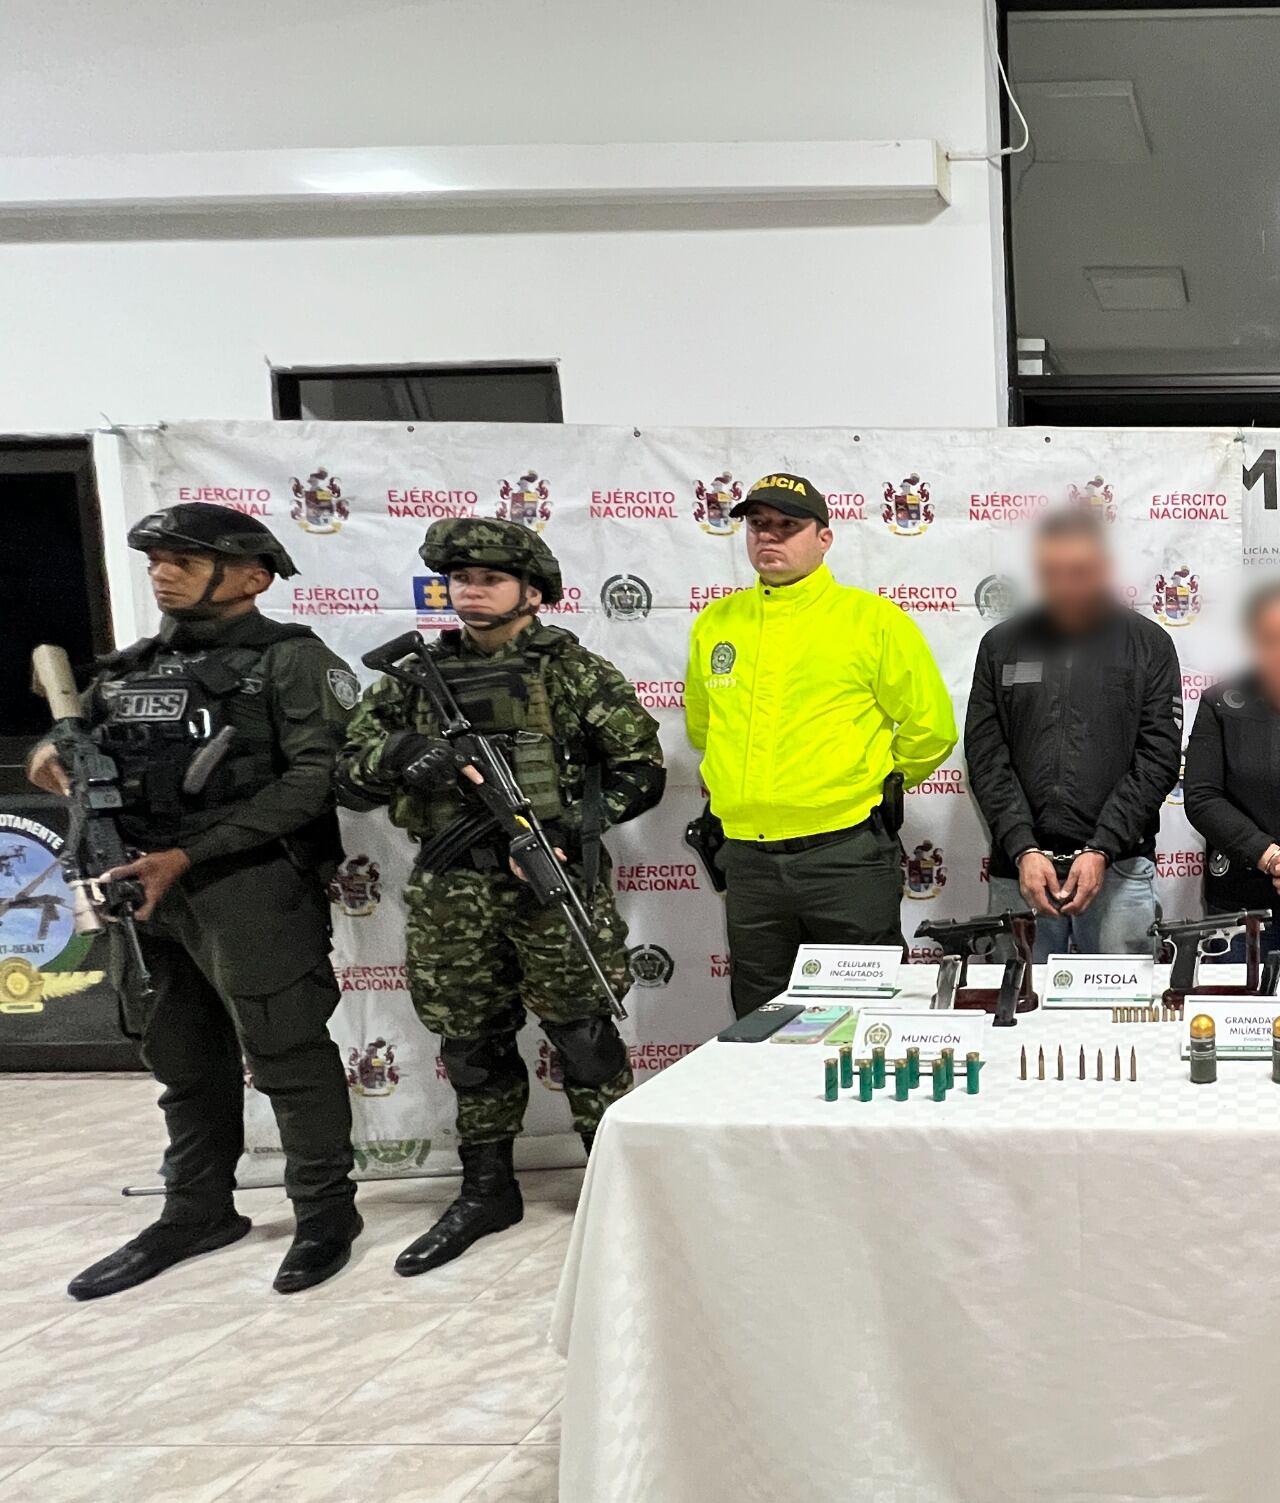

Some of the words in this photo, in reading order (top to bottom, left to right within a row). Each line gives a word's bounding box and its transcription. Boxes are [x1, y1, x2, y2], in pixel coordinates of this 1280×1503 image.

[388, 487, 478, 504] EJÉRCITO
[591, 488, 675, 504] EJÉRCITO
[826, 494, 865, 506] CITO
[970, 492, 1049, 507] EJÉRCITO
[1152, 491, 1227, 507] EJÉRCITO
[388, 505, 479, 518] NACIONAL
[590, 506, 678, 519] NACIONAL
[1150, 507, 1229, 520] NACIONAL
[294, 585, 379, 601] EJÉRCITO
[878, 584, 957, 600] EJÉRCITO
[292, 602, 384, 615] NACIONAL
[899, 602, 961, 613] CIONAL
[617, 863, 697, 878] EJÉRCITO
[616, 879, 700, 892] NACIONAL
[837, 960, 881, 969] CELULARES
[830, 970, 884, 978] INCAUTADOS
[1083, 974, 1138, 984] PISTOLA
[1229, 1027, 1272, 1035] MILÍMETR
[901, 1033, 961, 1043] MUNICIÓN
